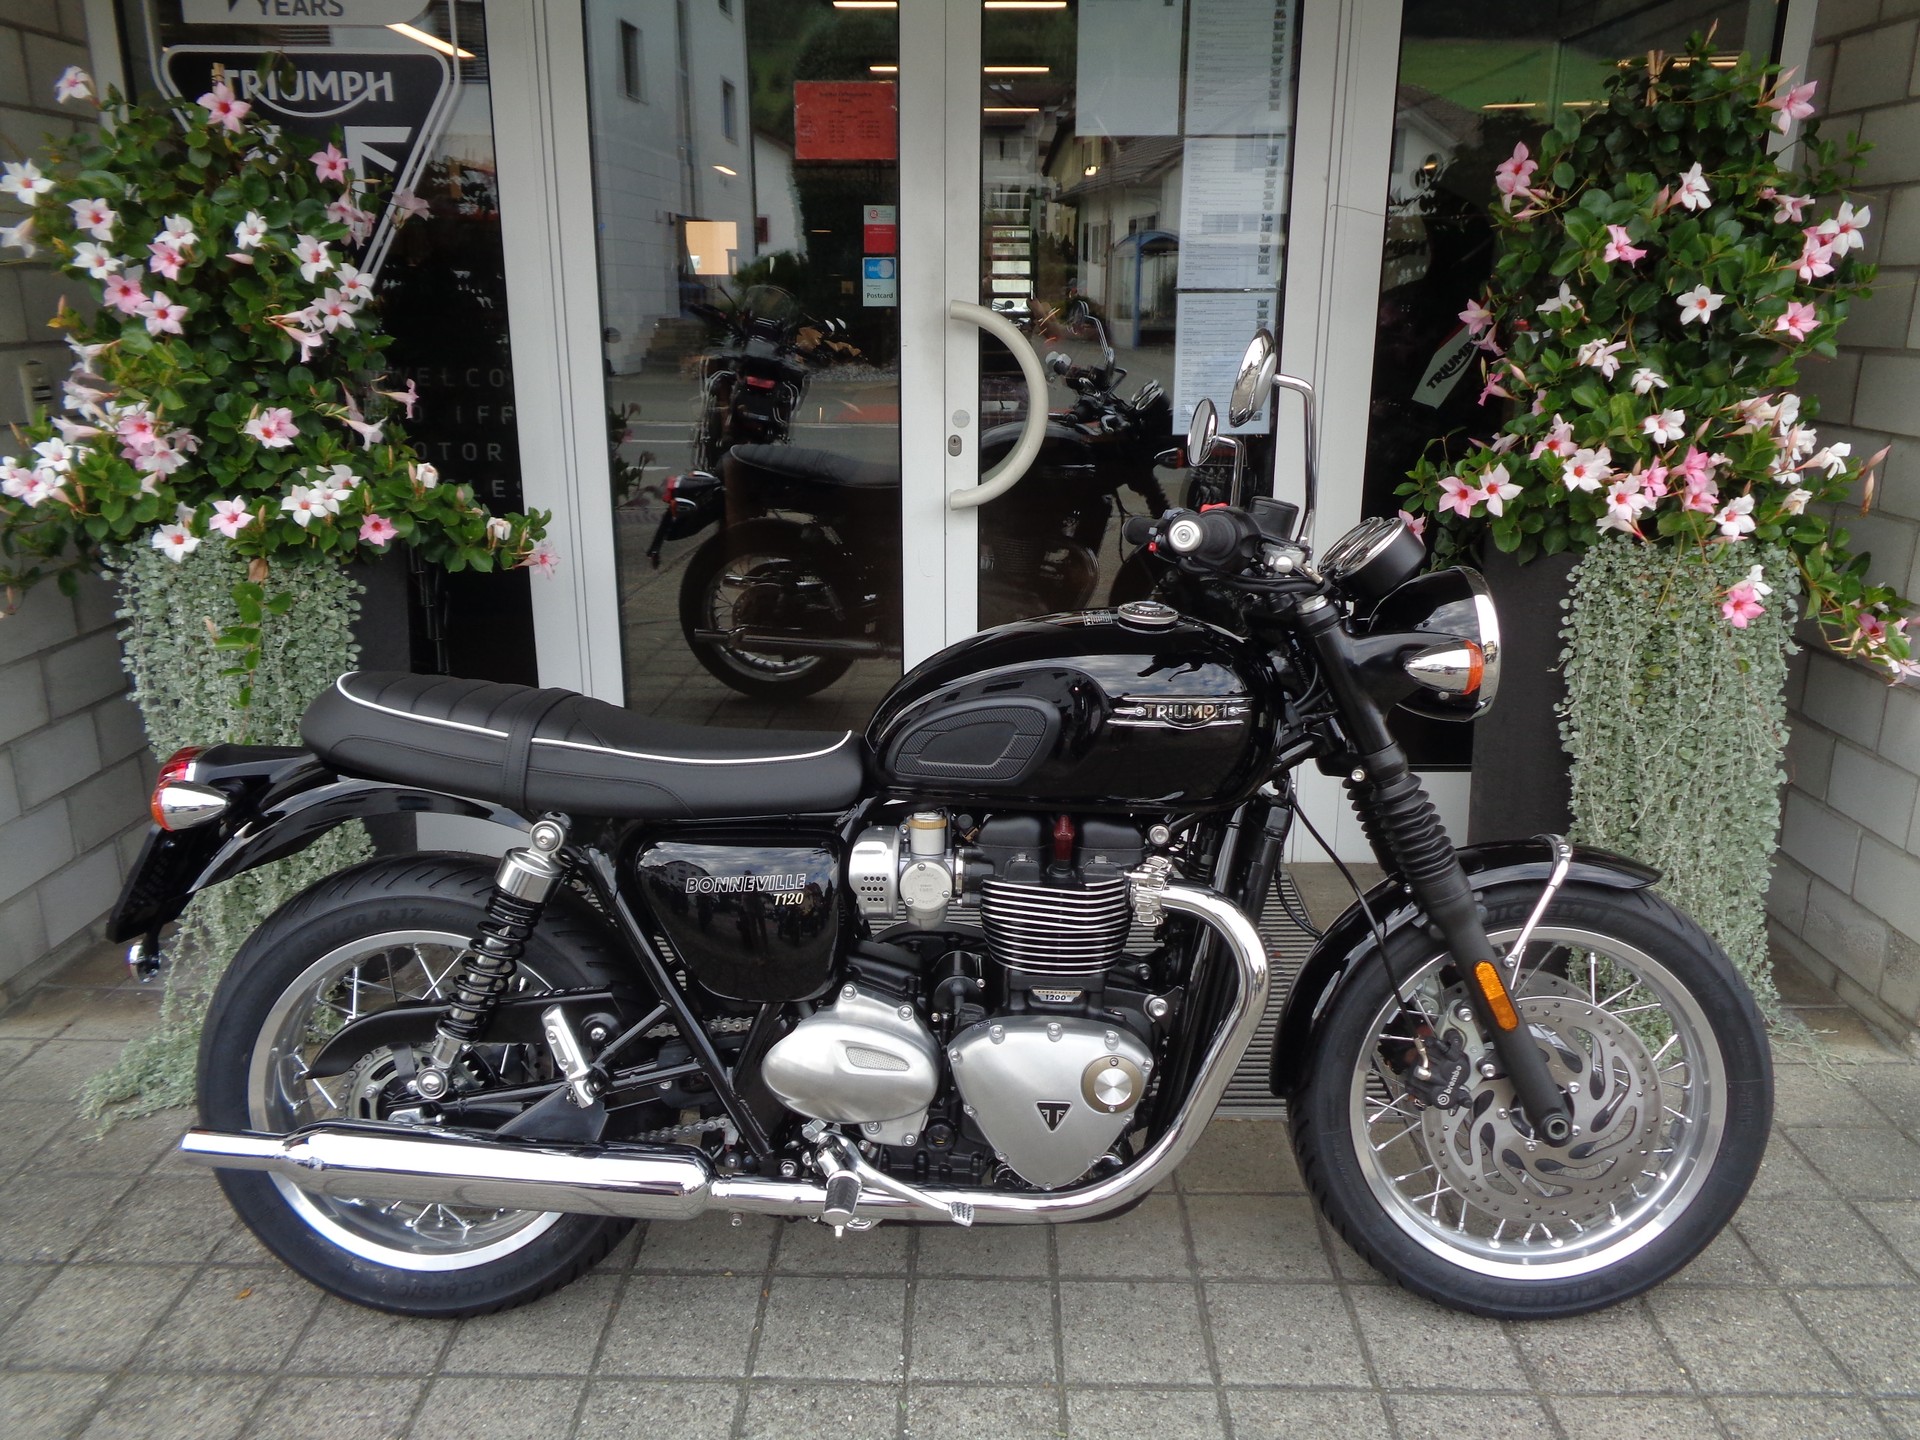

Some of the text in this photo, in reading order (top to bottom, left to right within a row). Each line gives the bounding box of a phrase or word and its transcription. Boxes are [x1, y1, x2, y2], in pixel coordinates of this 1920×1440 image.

[257, 0, 344, 16] YEARS
[211, 69, 394, 115] TRIUMPH
[866, 291, 894, 300] Postcard
[412, 441, 503, 462] OTOR
[1145, 704, 1228, 724] TRIUMPH
[685, 873, 806, 893] BONNEVILLE
[774, 893, 804, 905] T120
[1443, 1065, 1462, 1094] brembo
